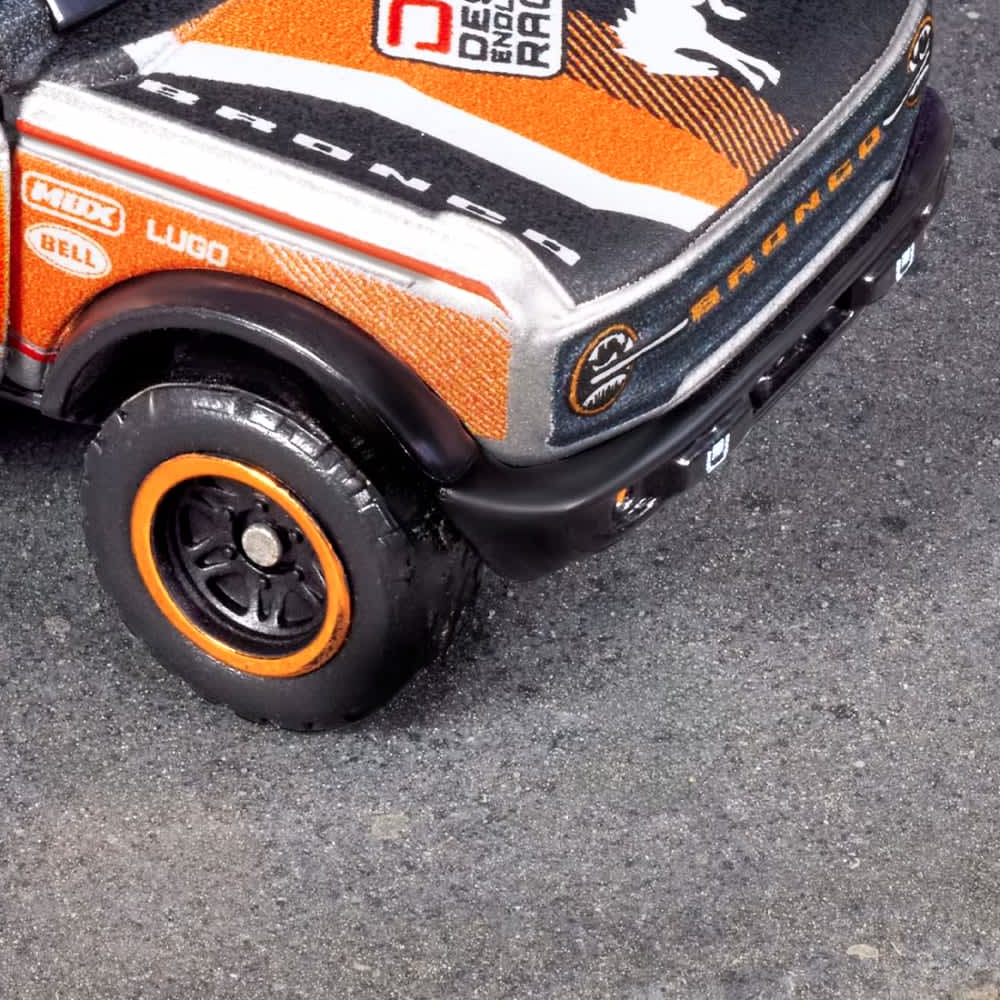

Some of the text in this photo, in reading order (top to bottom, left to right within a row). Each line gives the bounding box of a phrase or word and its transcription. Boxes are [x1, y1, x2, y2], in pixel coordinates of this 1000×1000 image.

[137, 79, 580, 267] BRONCO
[31, 181, 117, 227] MBX
[690, 126, 882, 323] BRONCO
[40, 233, 96, 269] BELL
[146, 218, 229, 268] LUGO
